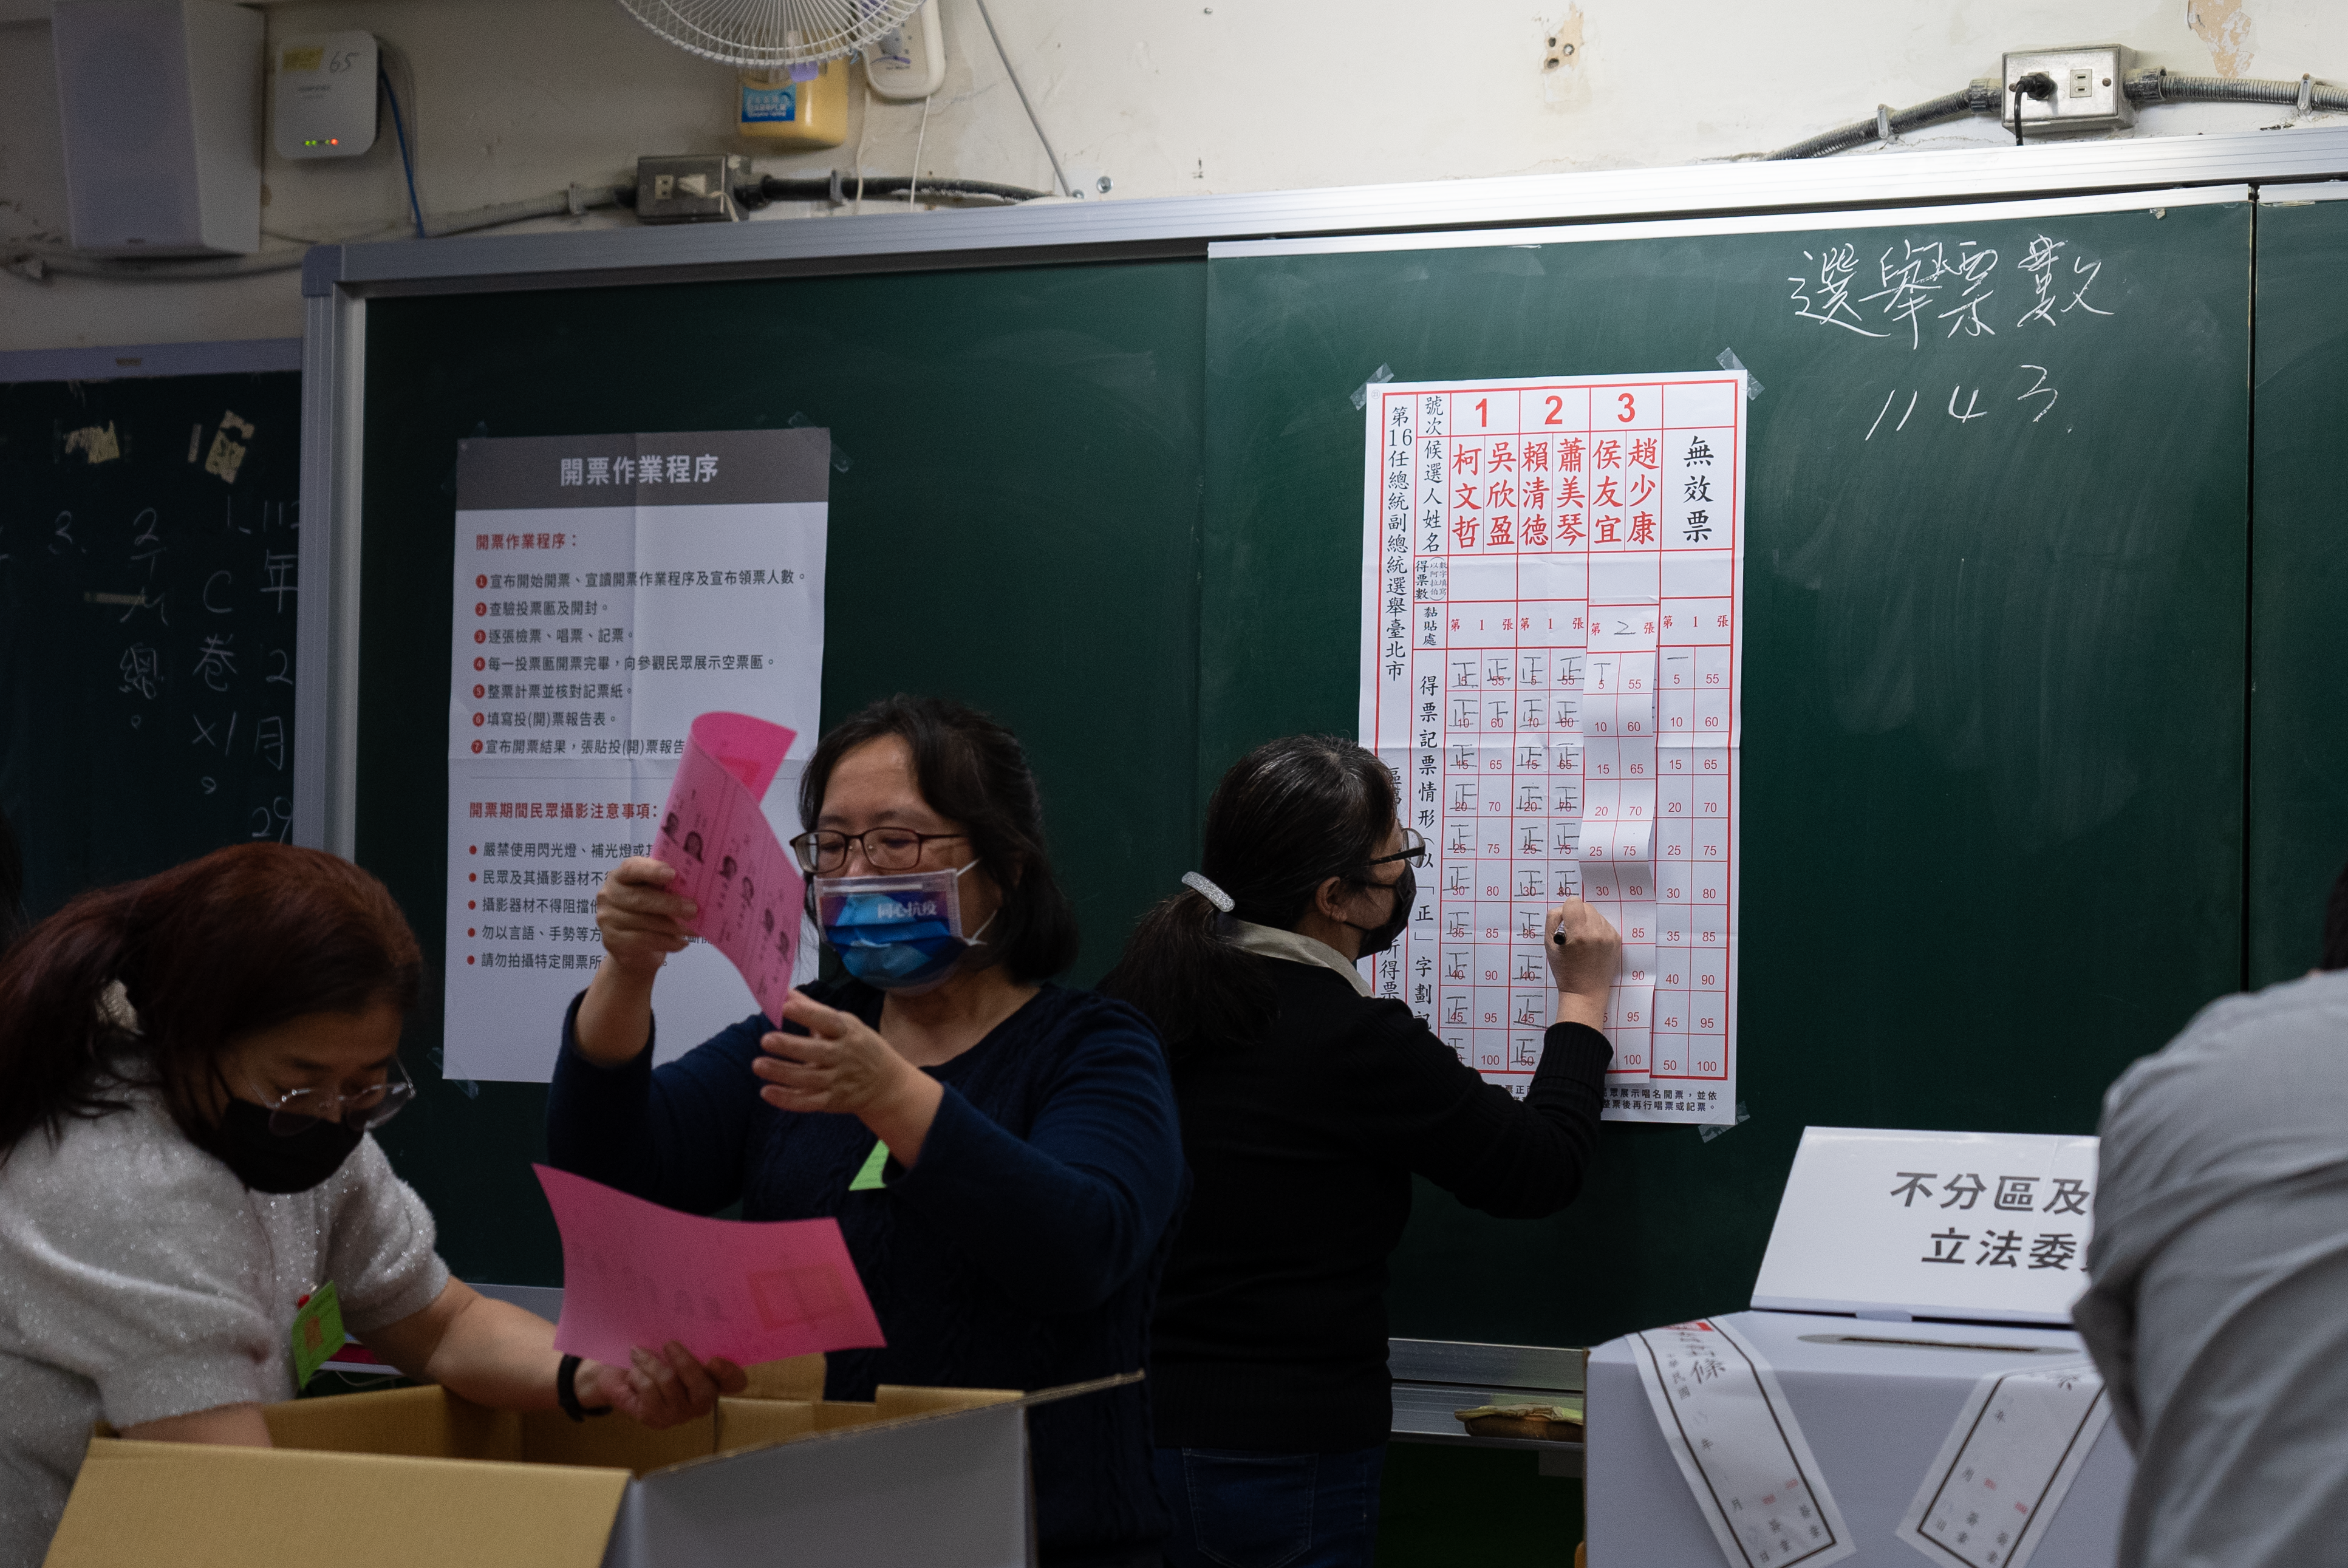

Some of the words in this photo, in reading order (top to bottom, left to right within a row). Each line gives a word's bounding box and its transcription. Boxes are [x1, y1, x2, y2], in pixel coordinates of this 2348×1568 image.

[330, 51, 360, 73] 65
[1425, 395, 1444, 436] 號次
[1475, 398, 1487, 428] 1
[1545, 395, 1563, 425] 2
[1617, 393, 1636, 423] 3
[561, 453, 720, 486] 開票作業程序
[1422, 439, 1444, 553] 候選人姓名
[1452, 443, 1482, 550] 柯文哲
[1486, 441, 1517, 548] 吳欣盈
[1520, 441, 1550, 547] 賴清德
[1556, 437, 1586, 547] 蕭美琴
[1592, 438, 1623, 545] 侯友宜
[1627, 437, 1660, 543] 趙少康
[1682, 435, 1714, 543] 無效票
[476, 532, 578, 550] 開票作業程序：
[1415, 560, 1429, 600] 得票數
[1629, 679, 1641, 689] 55
[1674, 674, 1680, 684] 5
[1707, 673, 1719, 684] 55
[1595, 721, 1607, 732] 10
[1627, 721, 1640, 732] 60
[1671, 717, 1682, 727] 10
[1705, 717, 1718, 727] 60
[1489, 759, 1502, 769] 65
[1597, 764, 1609, 774] 15
[1630, 764, 1643, 774] 65
[1670, 759, 1682, 769] 15
[1704, 759, 1717, 769] 65
[1489, 801, 1501, 812] 70
[1595, 806, 1608, 816] 20
[1630, 806, 1642, 816] 70
[1668, 802, 1681, 813] 20
[1704, 802, 1717, 813] 70
[1488, 844, 1500, 854] 75
[1590, 847, 1602, 857] 25
[1624, 846, 1636, 856] 75
[1668, 845, 1681, 855] 25
[1704, 845, 1716, 856] 75
[1486, 886, 1499, 896] 80
[1597, 887, 1609, 896] 30
[1630, 886, 1642, 896] 80
[1668, 888, 1680, 898] 30
[1702, 888, 1716, 899] 80
[1486, 928, 1499, 938] 85
[1632, 927, 1645, 938] 85
[1667, 931, 1680, 941] 35
[1702, 932, 1716, 942] 85
[481, 952, 605, 970] 請勿拍攝特定開票所
[1486, 970, 1498, 980] 90
[1632, 971, 1643, 980] 90
[1666, 974, 1679, 984] 40
[1701, 975, 1715, 985] 90
[1484, 1012, 1497, 1023] 95
[1627, 1012, 1639, 1022] 95
[1665, 1017, 1678, 1027] 45
[1701, 1018, 1714, 1028] 95
[1482, 1055, 1500, 1065] 100
[1625, 1055, 1641, 1065] 100
[1664, 1060, 1677, 1070] 50
[1698, 1062, 1717, 1071] 100
[1890, 1171, 2090, 1216] 不分區及
[1922, 1227, 2090, 1272] 立法委
